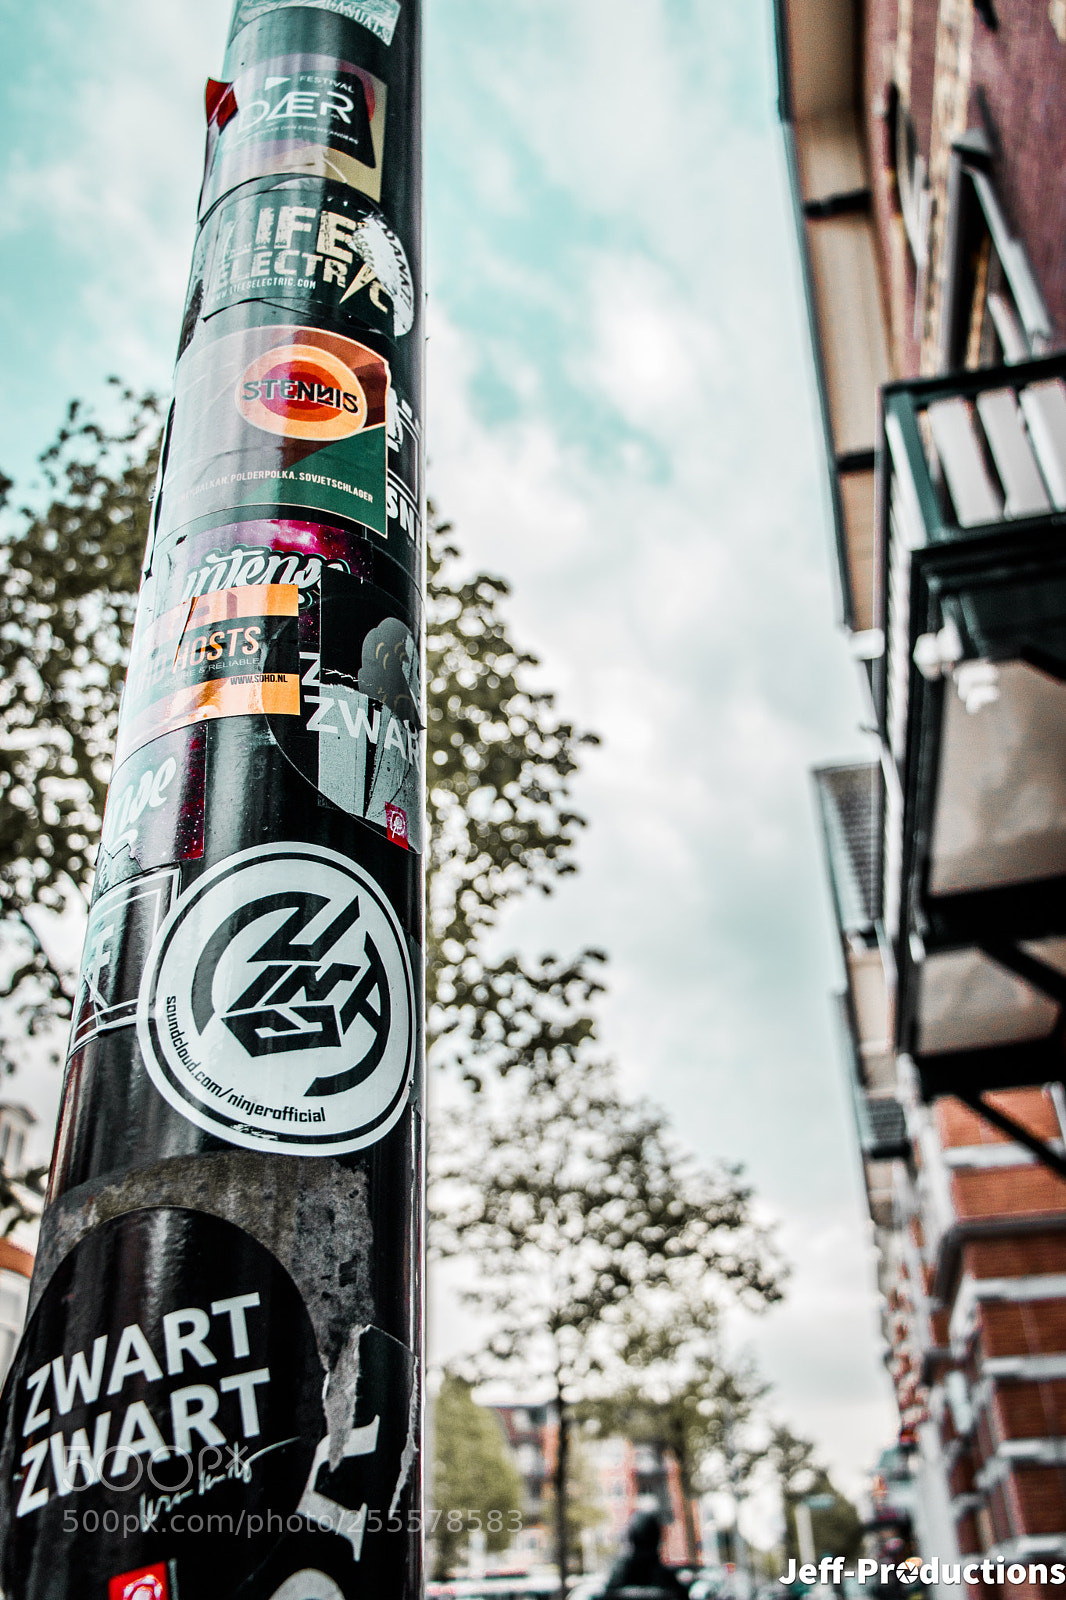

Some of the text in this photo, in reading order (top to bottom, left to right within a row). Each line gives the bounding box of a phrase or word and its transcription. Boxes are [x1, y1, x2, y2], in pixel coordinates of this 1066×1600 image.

[300, 75, 355, 93] FESTIVAL
[172, 625, 262, 674] HOSTS
[208, 657, 260, 672] RELIABLE
[230, 674, 289, 686] WWW.SOHO.NL
[166, 995, 326, 1123] soundcloud.com/ninjerofficial
[22, 1291, 260, 1438] ZWART
[16, 1367, 271, 1518] ZWART
